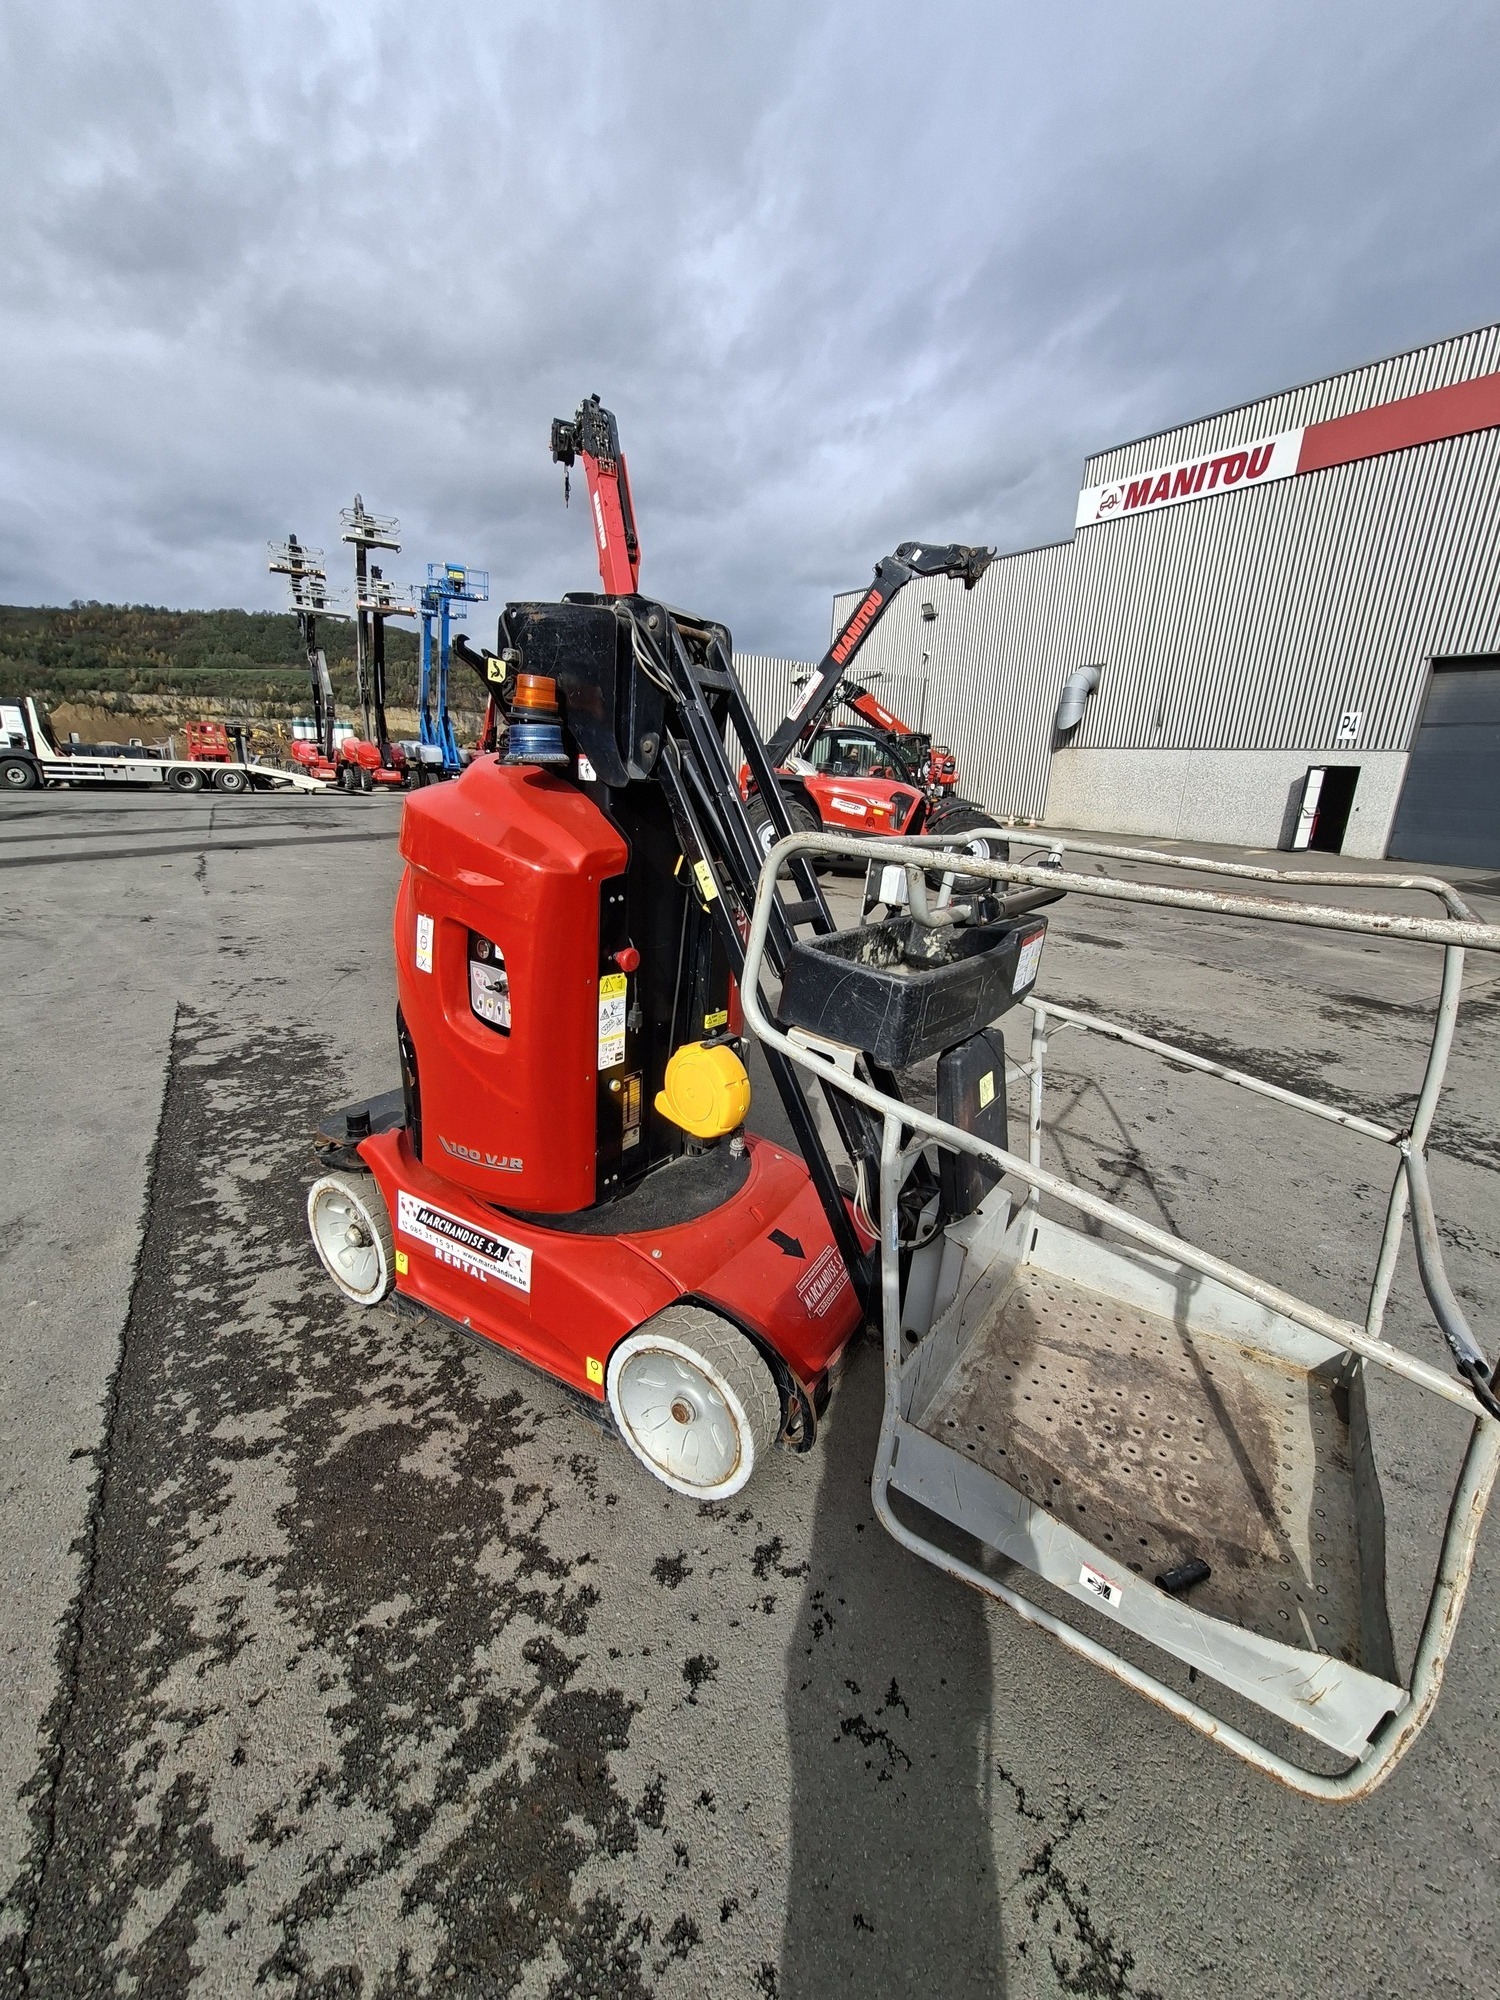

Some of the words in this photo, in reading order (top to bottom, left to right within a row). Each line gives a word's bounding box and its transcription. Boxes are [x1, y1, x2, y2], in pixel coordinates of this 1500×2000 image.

[1123, 442, 1276, 510] MANITOU
[831, 589, 883, 664] MANITOU
[1340, 715, 1359, 736] P4
[450, 1141, 481, 1161] 100
[485, 1153, 523, 1169] VJR
[410, 1224, 423, 1236] 085
[425, 1231, 432, 1240] 31
[435, 1236, 444, 1246] 15
[446, 1242, 454, 1251] 91
[462, 1250, 527, 1287] www.marchandise.be
[418, 1210, 485, 1250] MARCHANDISE
[485, 1242, 504, 1260] S.A.
[434, 1247, 488, 1283] RENTAL
[803, 1260, 838, 1311] MARCHANDISE
